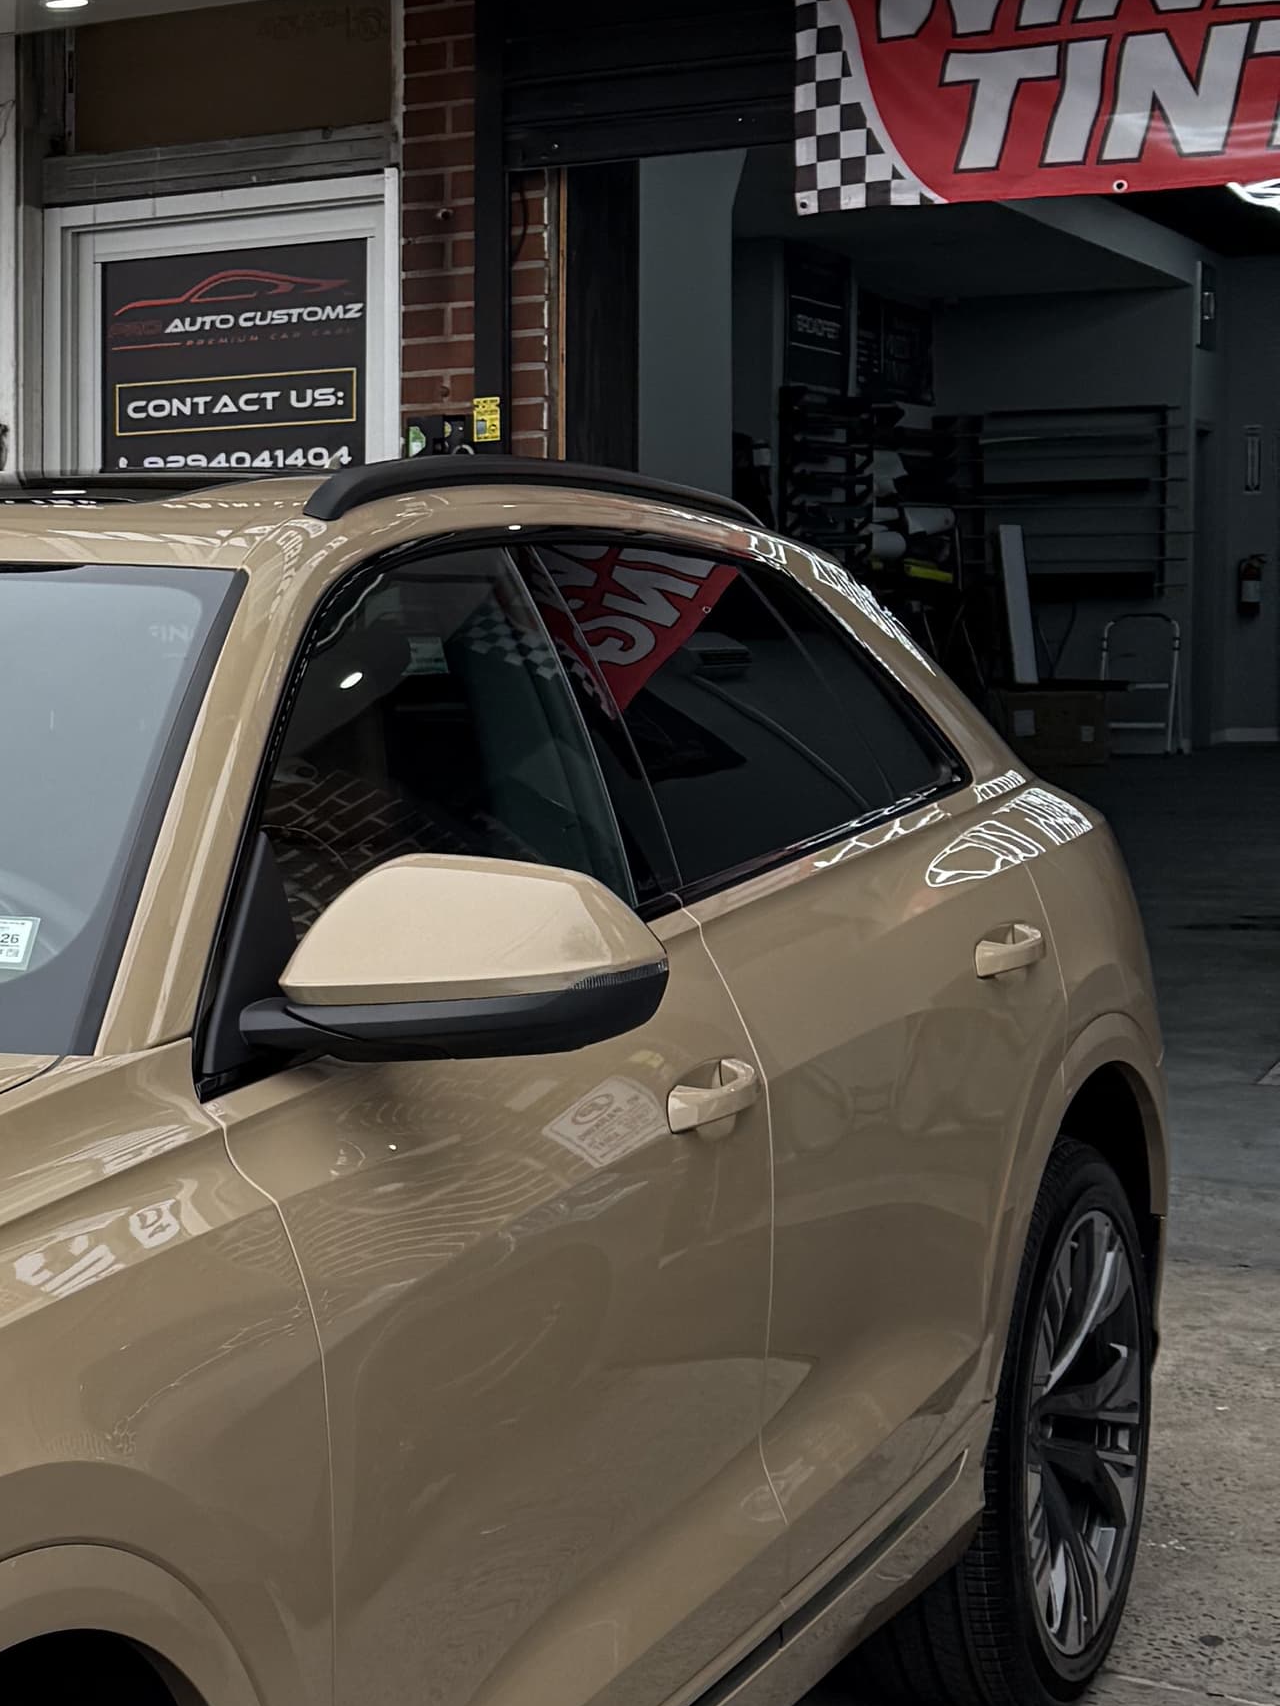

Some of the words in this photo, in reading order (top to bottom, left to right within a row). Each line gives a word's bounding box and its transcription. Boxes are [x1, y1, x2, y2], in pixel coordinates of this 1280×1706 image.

[939, 8, 1280, 173] TIN
[164, 314, 234, 334] AUTO
[239, 303, 364, 327] CUSTOMZ
[127, 392, 280, 419] CONTACT
[290, 388, 344, 408] US:
[0, 933, 20, 944] 26
